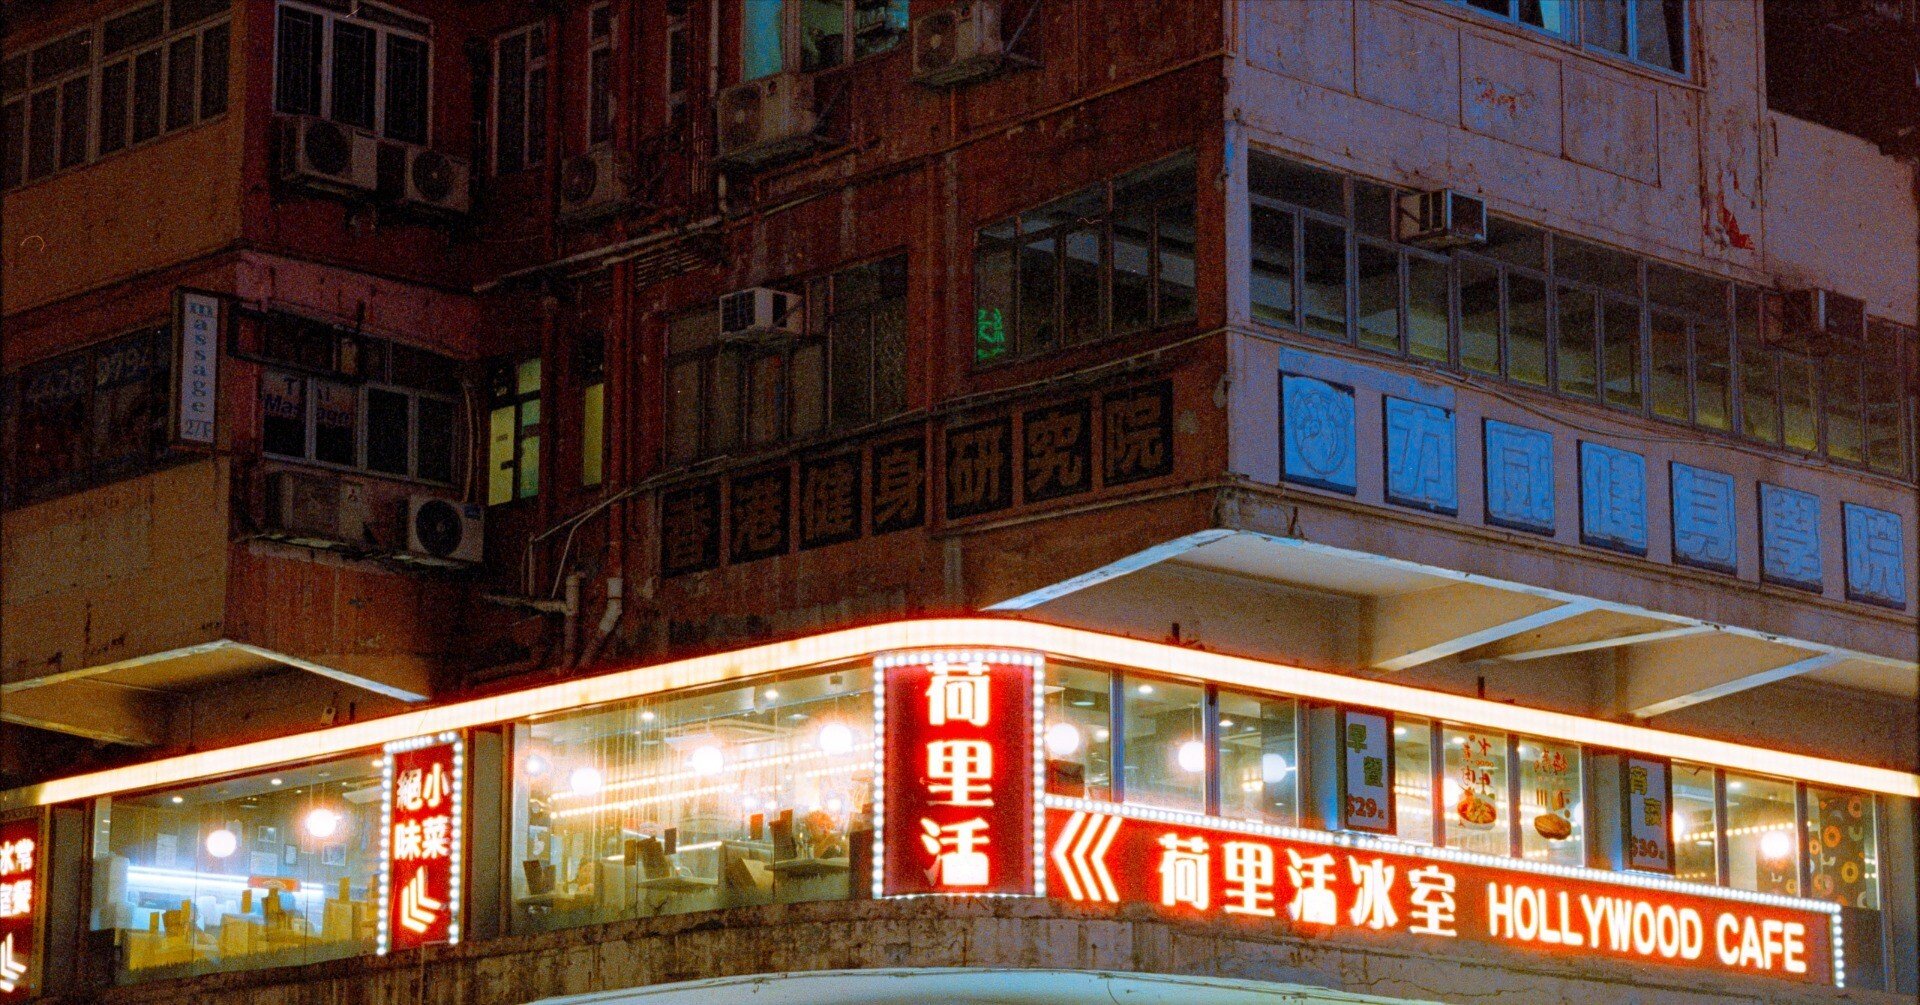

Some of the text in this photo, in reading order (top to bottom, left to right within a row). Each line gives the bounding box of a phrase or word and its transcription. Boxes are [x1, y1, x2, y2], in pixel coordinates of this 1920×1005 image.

[188, 301, 213, 413] massage
[184, 418, 212, 440] 2/F
[664, 392, 1165, 568] 香港健身研究院
[921, 661, 995, 886] 荷里活
[1158, 833, 1457, 937] 荷里活冰室
[1487, 881, 1807, 974] HOLLYWOOD CAFE
